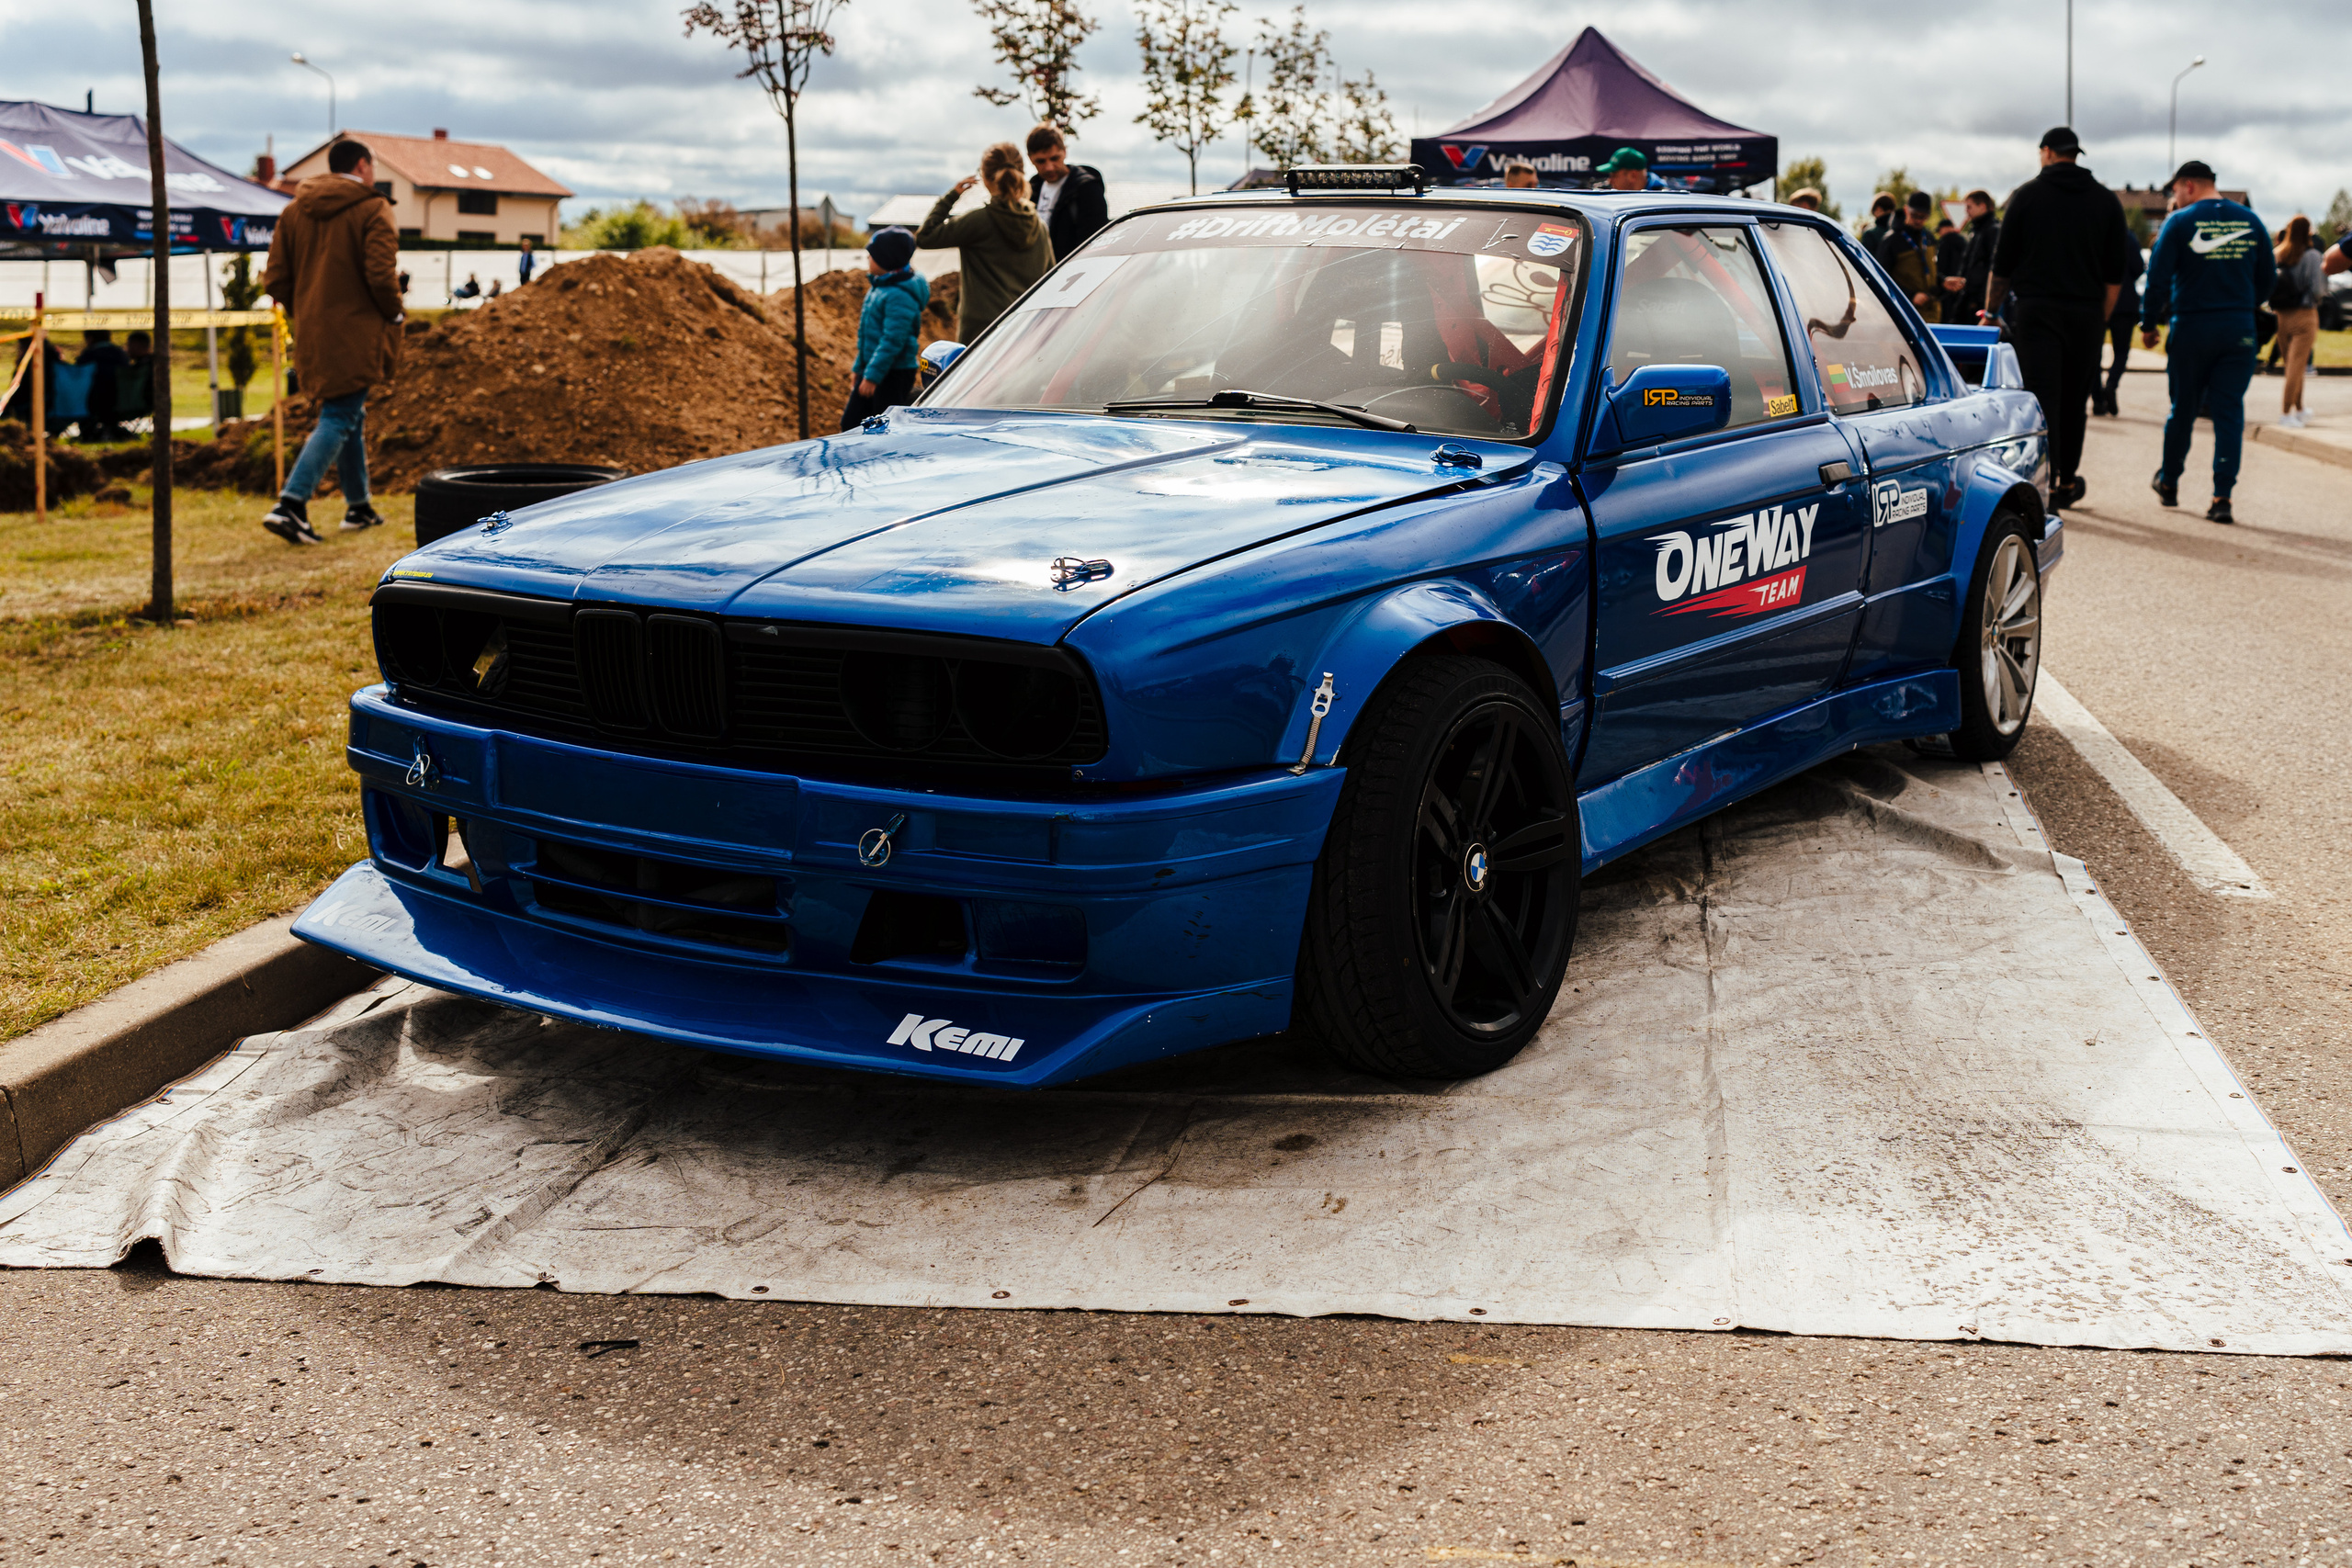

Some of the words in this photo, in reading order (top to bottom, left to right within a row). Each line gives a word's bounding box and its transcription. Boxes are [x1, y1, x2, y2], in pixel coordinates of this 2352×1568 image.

[1058, 272, 1087, 292] 1
[1770, 397, 1796, 415] Sabelt
[1901, 491, 1926, 505] INDIVIDUAL
[1892, 506, 1910, 519] RACING
[1910, 502, 1927, 513] PARTS
[1747, 574, 1801, 606] TEAM
